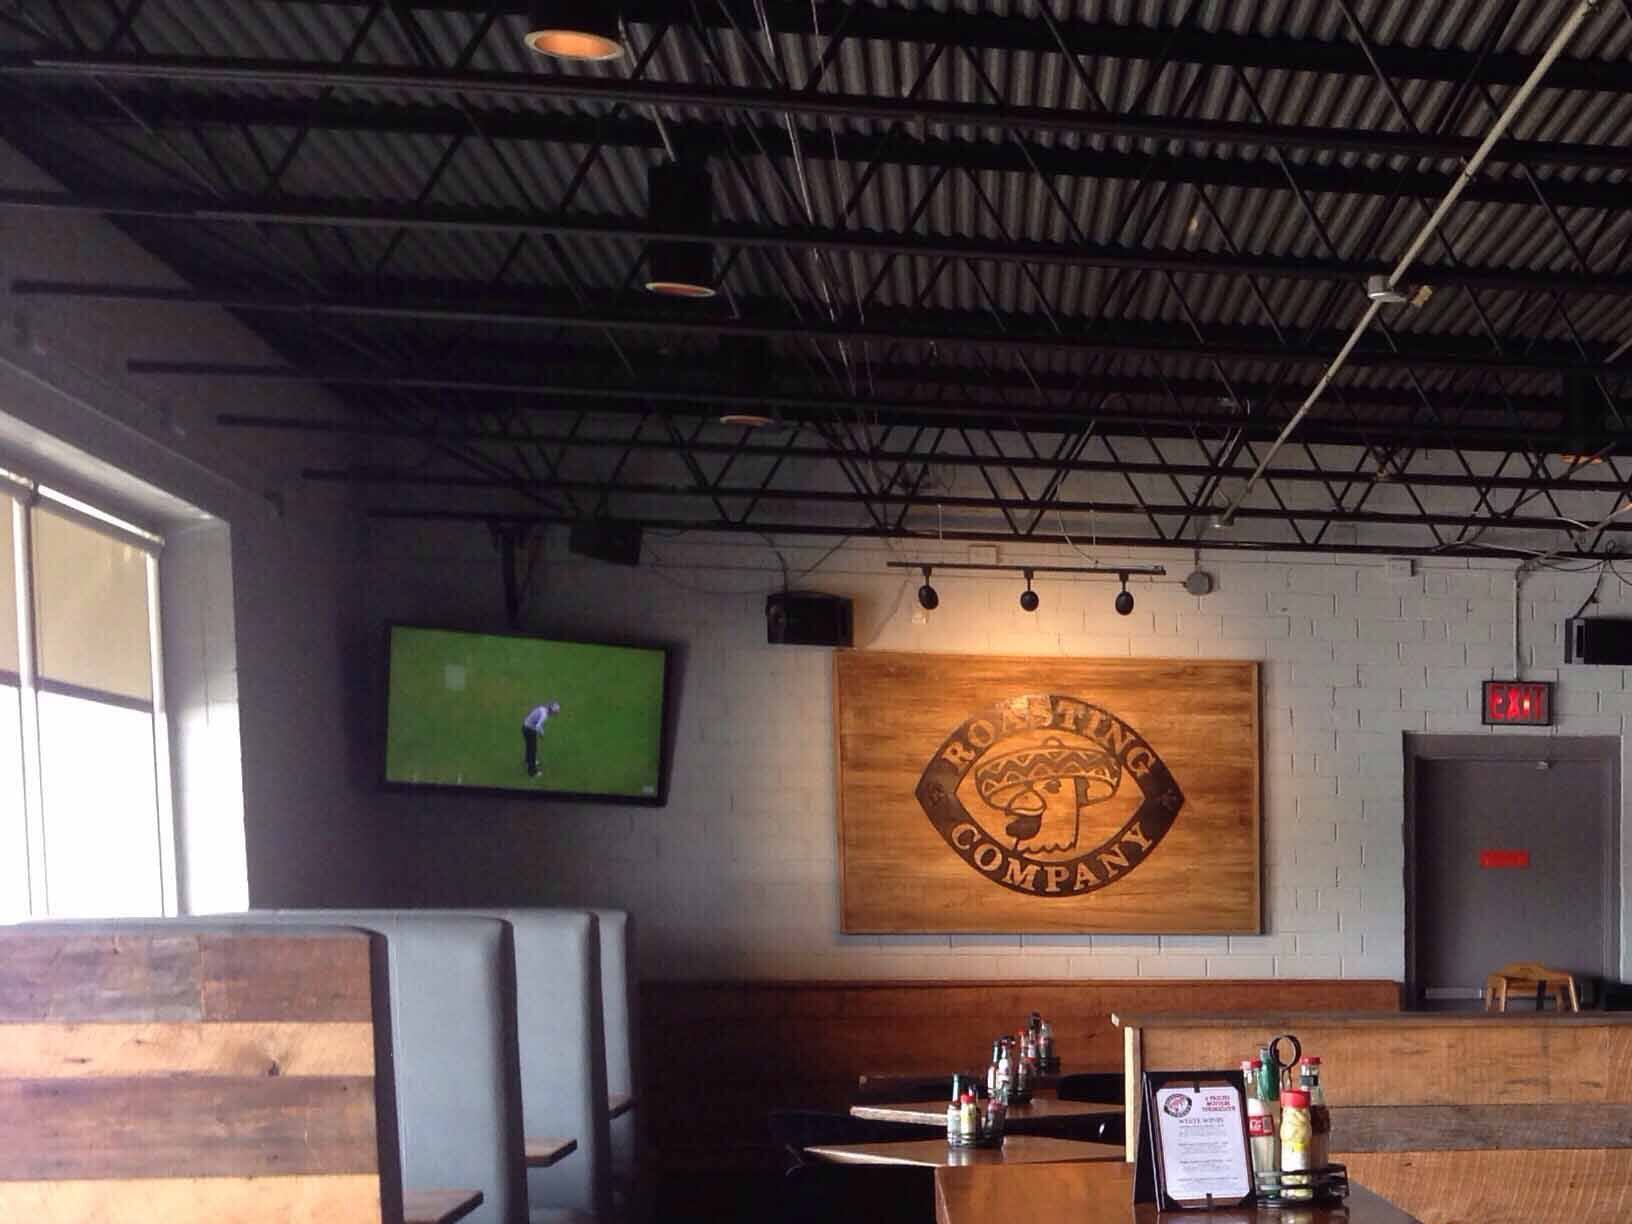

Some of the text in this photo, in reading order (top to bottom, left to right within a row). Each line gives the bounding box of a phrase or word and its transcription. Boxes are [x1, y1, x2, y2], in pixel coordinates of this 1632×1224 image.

[941, 695, 1156, 776] ROASTING
[1489, 686, 1544, 720] EXIT
[951, 821, 1153, 893] COMPANY
